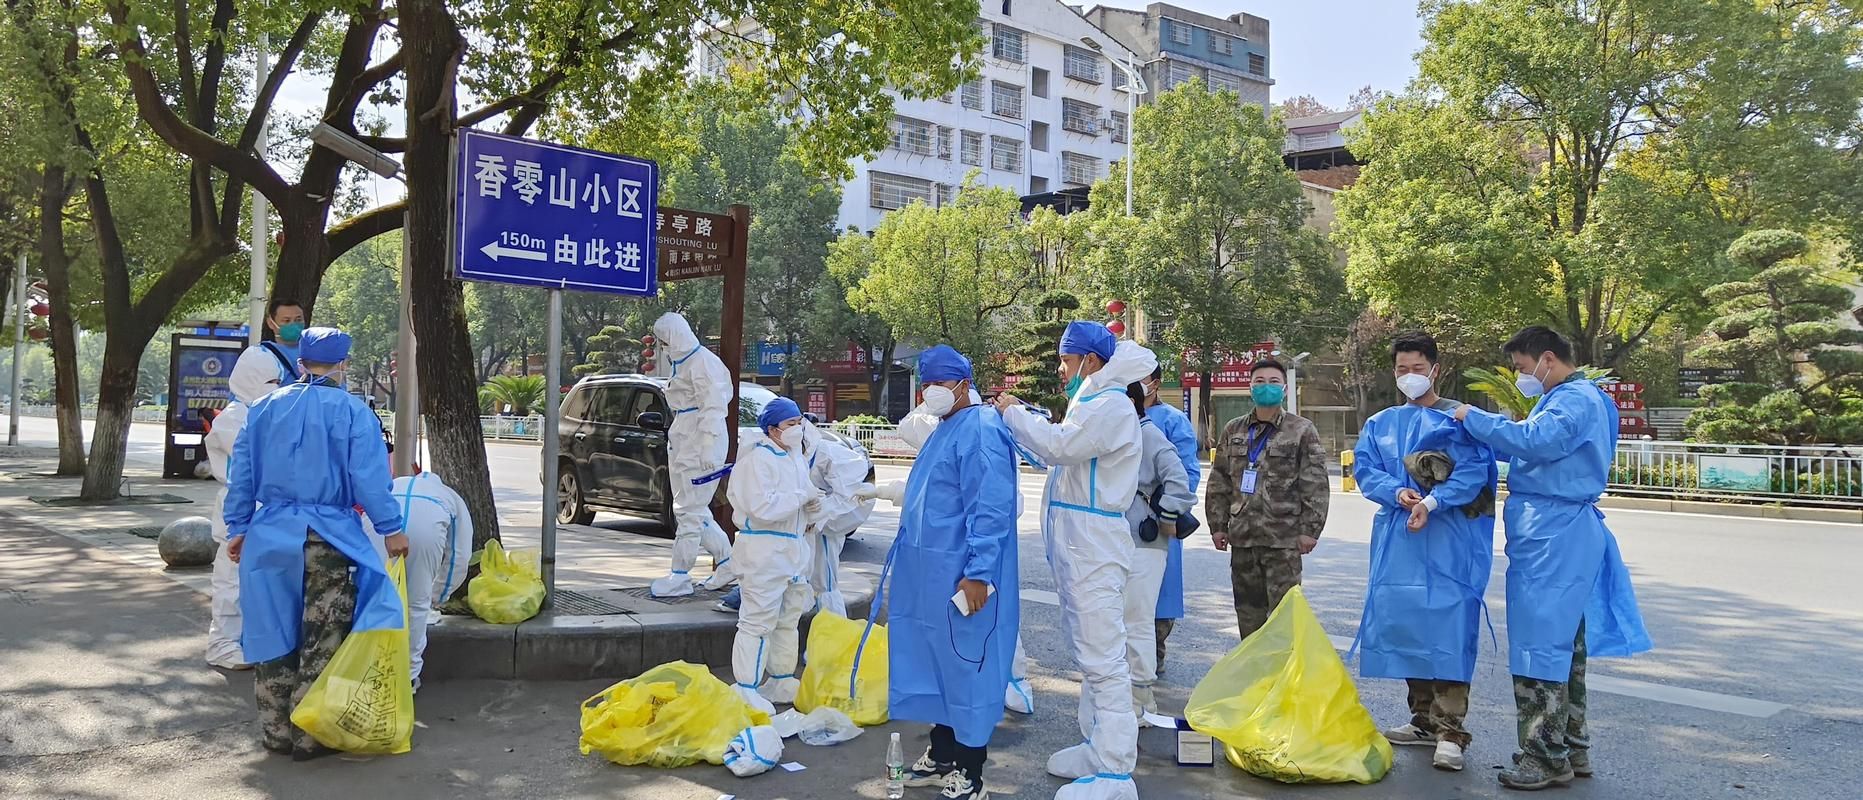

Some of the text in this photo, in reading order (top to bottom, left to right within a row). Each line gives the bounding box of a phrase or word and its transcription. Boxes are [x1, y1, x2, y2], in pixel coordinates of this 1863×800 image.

[474, 153, 643, 219] 香零山小区
[500, 231, 546, 250] 150m
[706, 242, 718, 250] LU
[554, 234, 641, 273] 由此进
[1413, 729, 1429, 739] N
